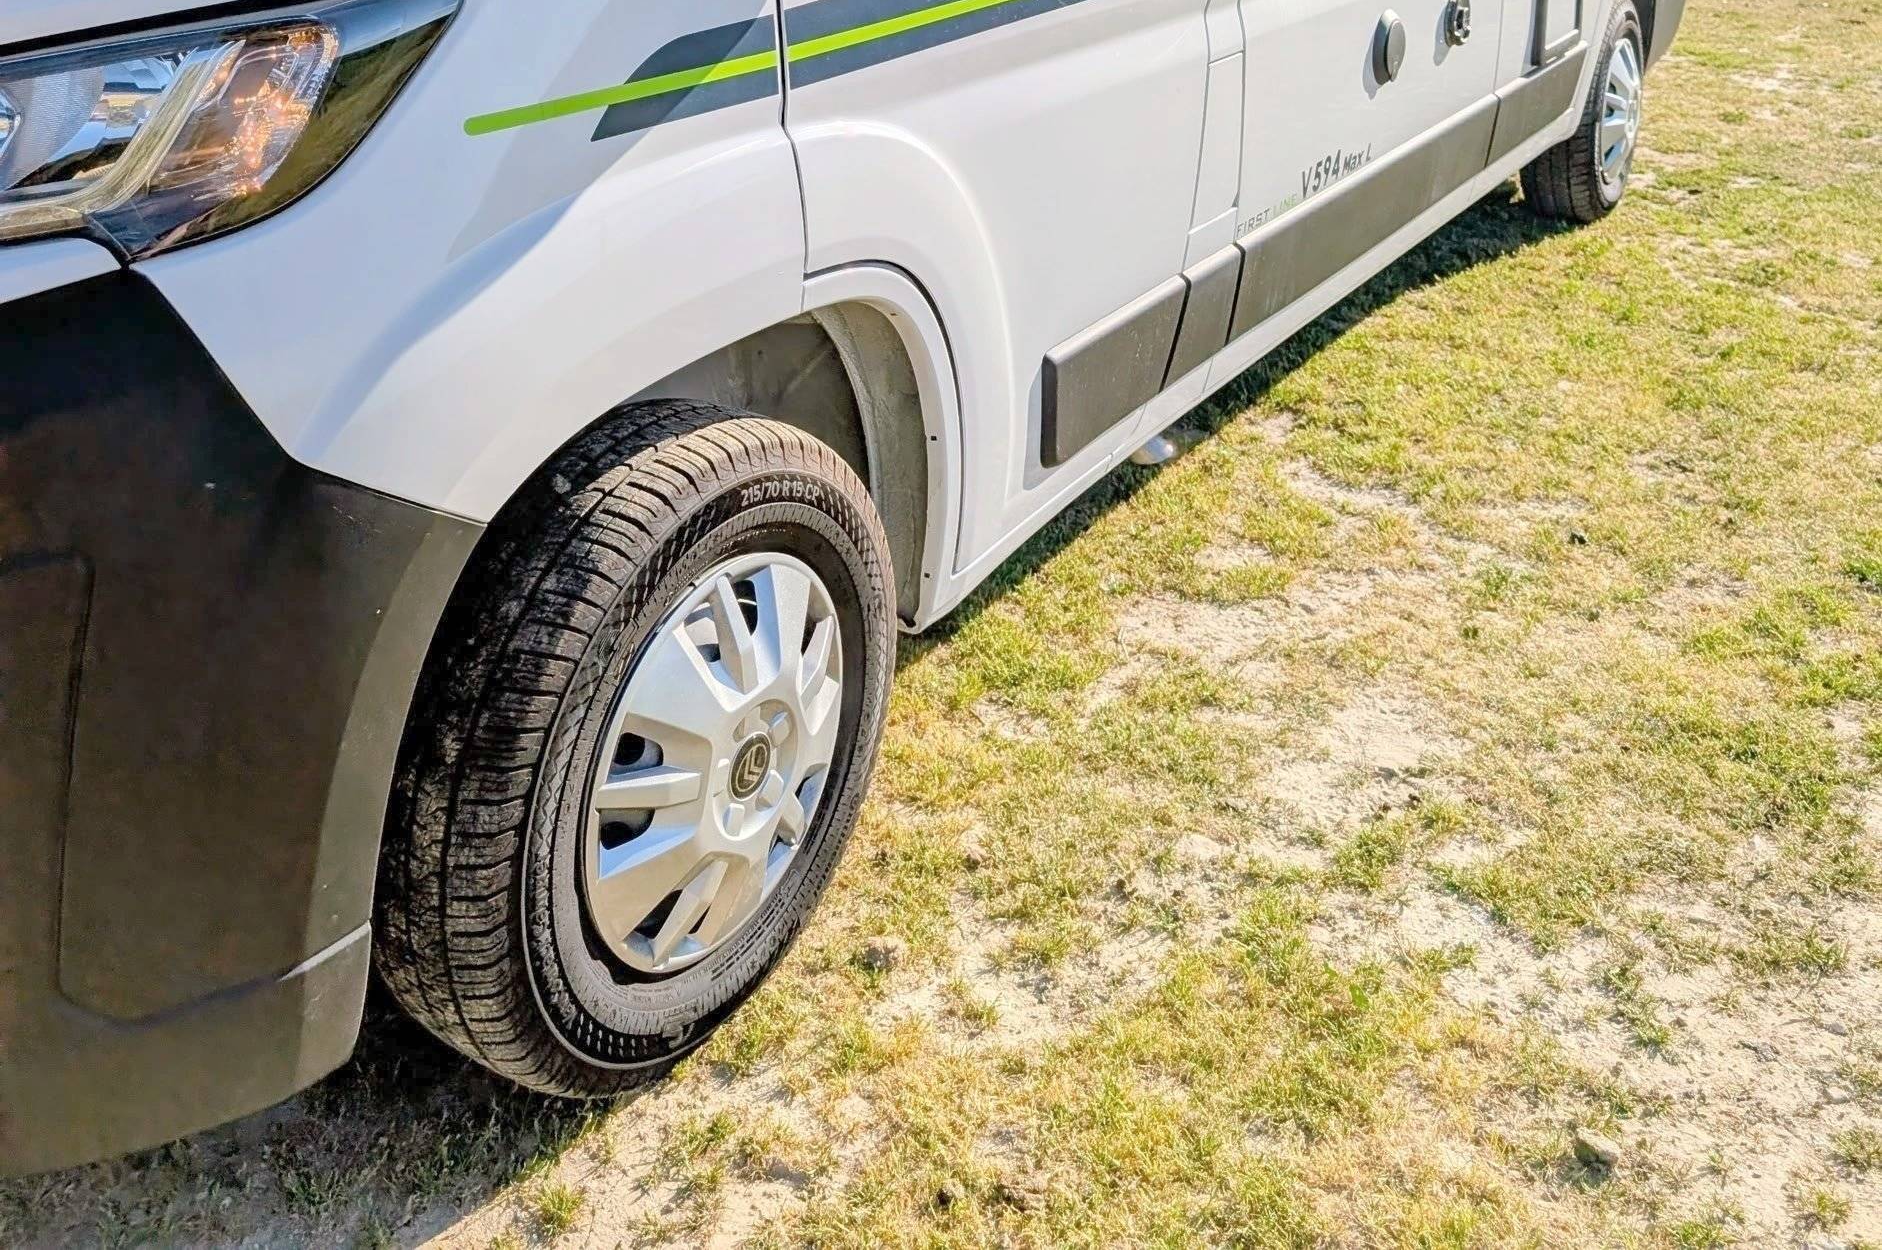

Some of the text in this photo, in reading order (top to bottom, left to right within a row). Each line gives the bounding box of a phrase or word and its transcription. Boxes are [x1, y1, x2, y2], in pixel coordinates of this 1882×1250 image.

[1236, 208, 1269, 238] FIRST
[1342, 150, 1364, 176] Max
[741, 481, 780, 507] 215/70
[782, 480, 790, 497] R
[793, 481, 803, 497] 15
